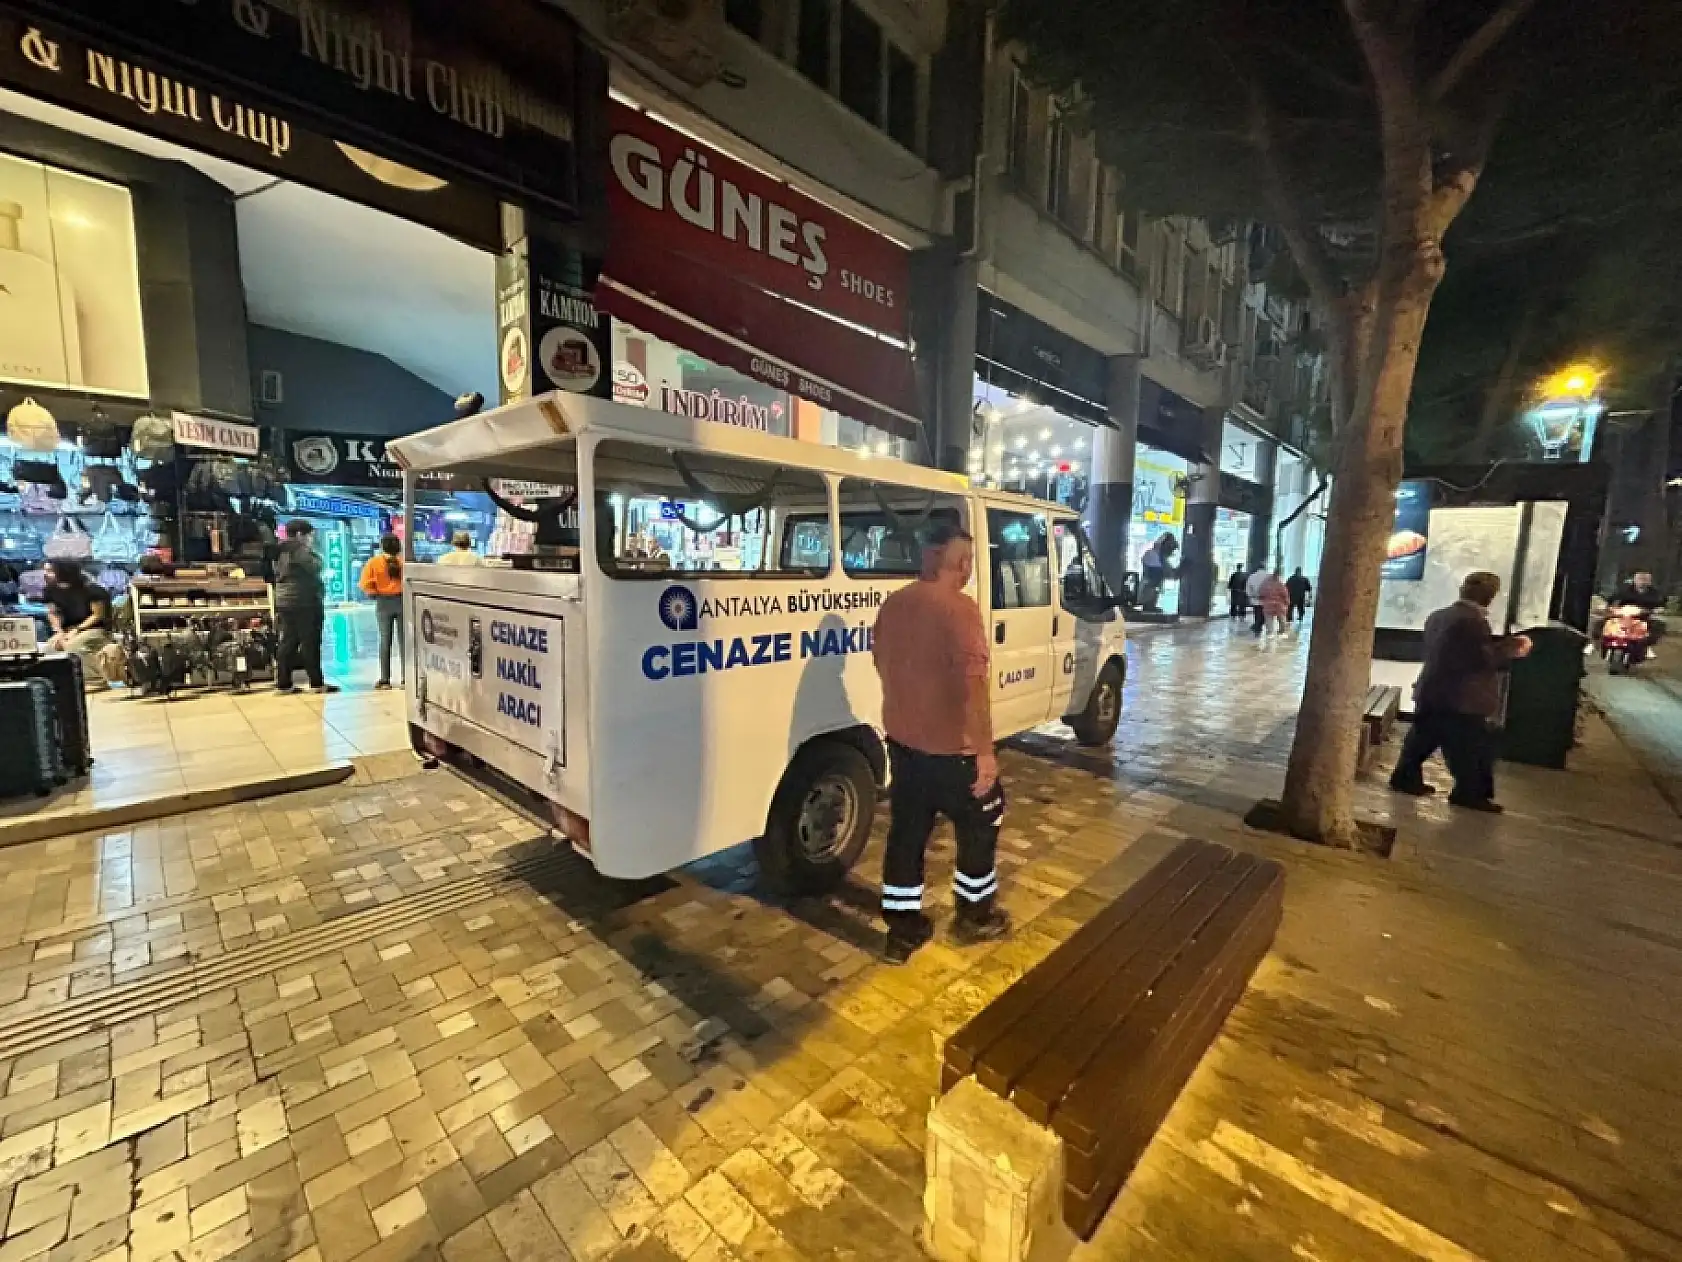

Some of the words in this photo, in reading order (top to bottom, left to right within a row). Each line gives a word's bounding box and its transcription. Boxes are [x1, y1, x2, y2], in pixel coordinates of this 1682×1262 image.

[20, 26, 61, 72] &
[302, 2, 414, 101] Night
[610, 133, 829, 290] GÜNEŞ
[840, 269, 894, 308] SHOES
[661, 378, 767, 431] İNDİRİM
[798, 377, 831, 402] SHOES
[700, 596, 783, 619] ANTALYA
[787, 587, 881, 613] BÜYÜKŞEHİR
[491, 620, 548, 654] CENAZE
[641, 633, 792, 680] CENAZE
[497, 657, 541, 690] NAKİL
[497, 692, 541, 728] ARACI
